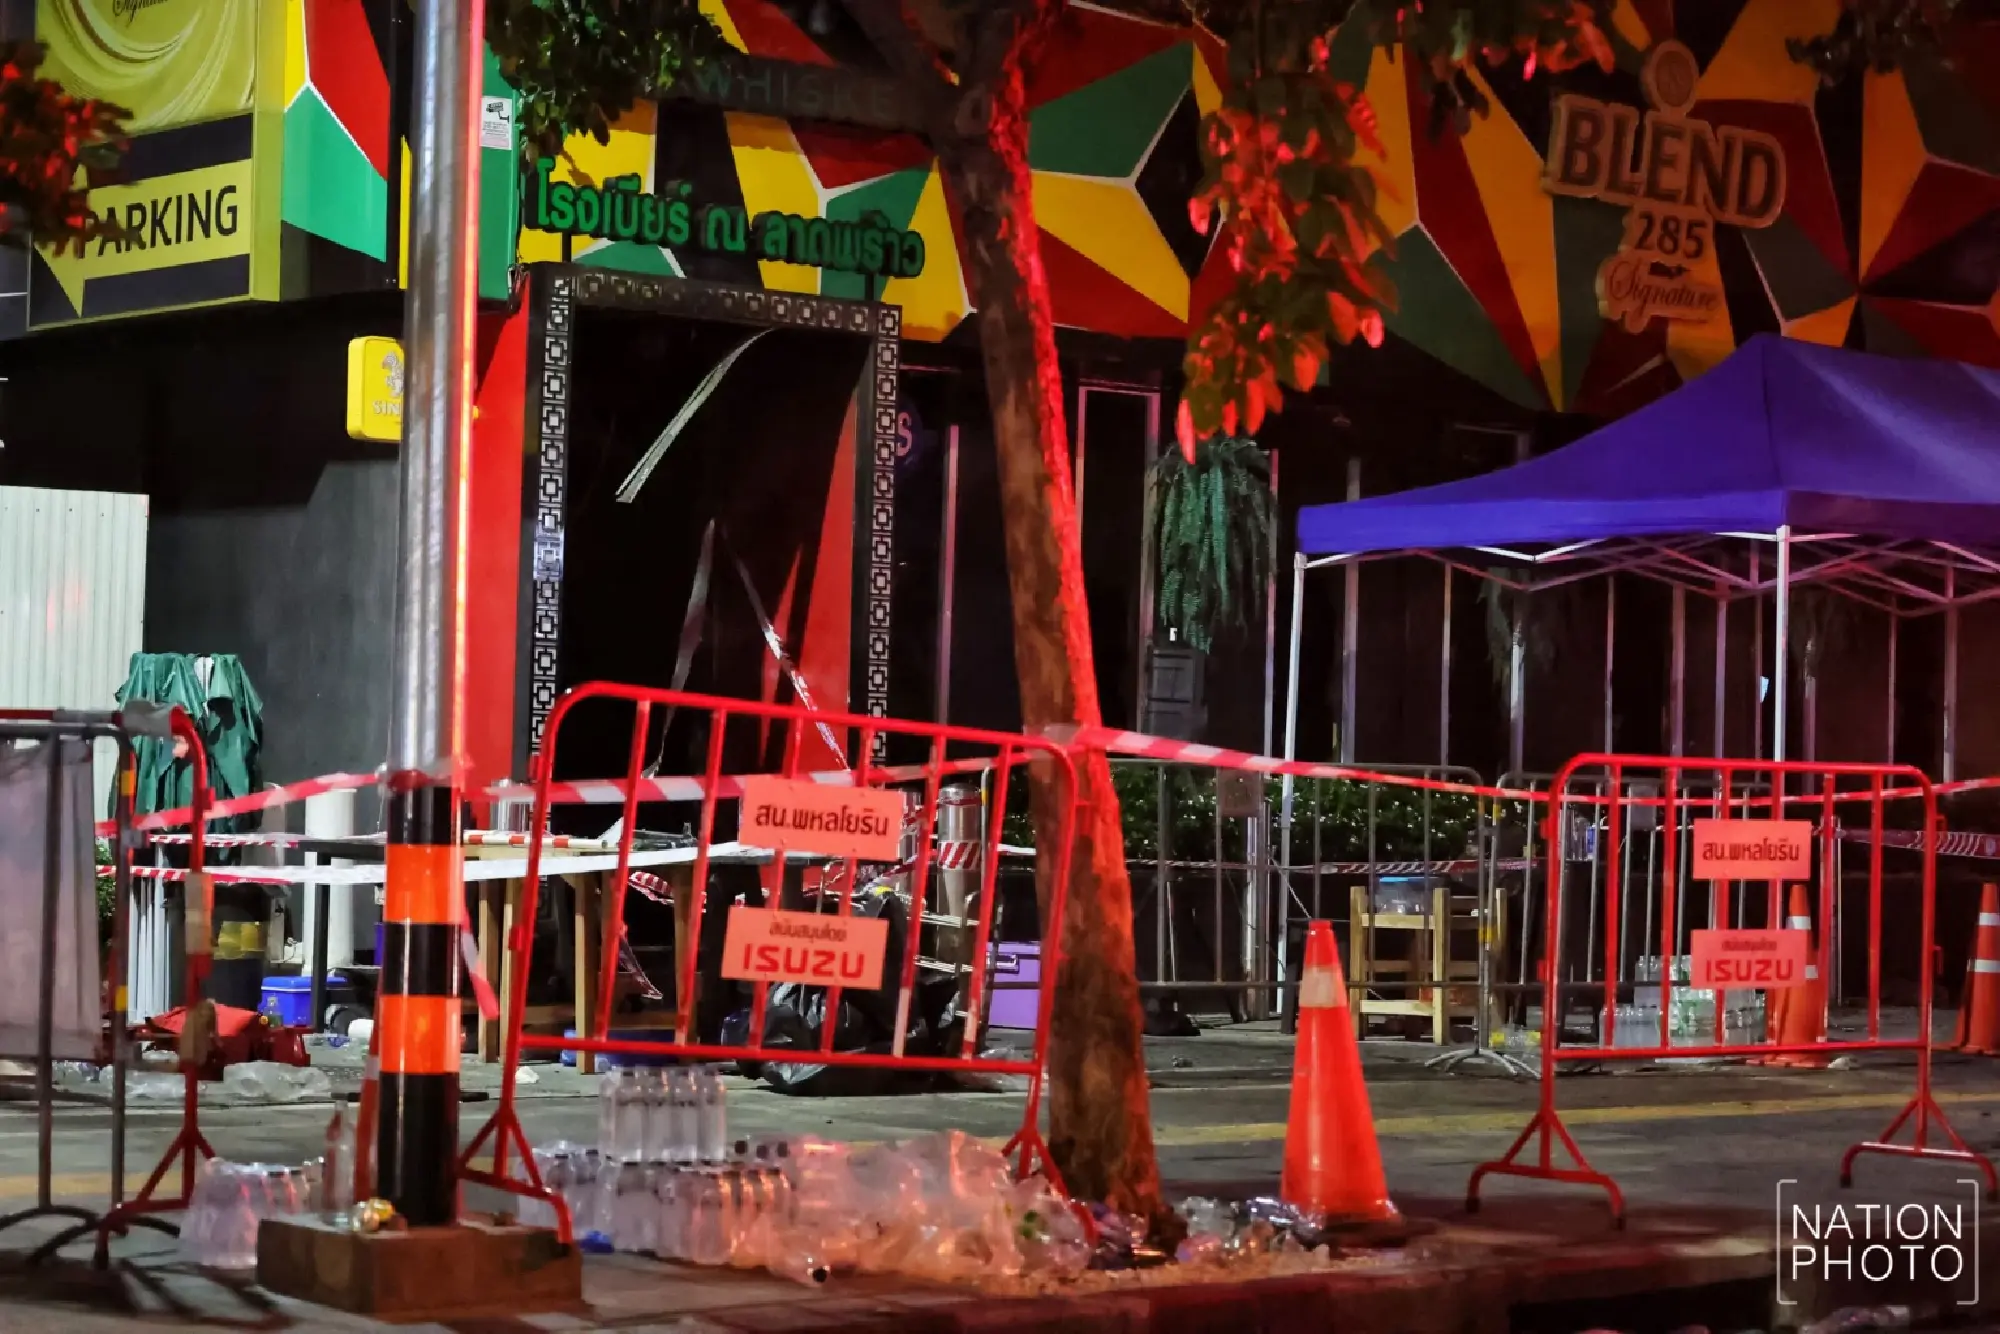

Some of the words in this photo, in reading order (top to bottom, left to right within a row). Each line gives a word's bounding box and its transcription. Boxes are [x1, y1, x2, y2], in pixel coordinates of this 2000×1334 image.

[693, 60, 899, 122] WHISKE
[1561, 107, 1778, 218] BLEND
[536, 157, 690, 245] โรงเบียร์
[707, 206, 747, 252] ณ
[763, 209, 925, 279] ลาดพร้าว
[1633, 210, 1708, 260] 285
[1610, 258, 1719, 317] Signature
[372, 400, 402, 415] SIN
[743, 943, 864, 979] ISUZU
[1706, 958, 1793, 982] ISUZU
